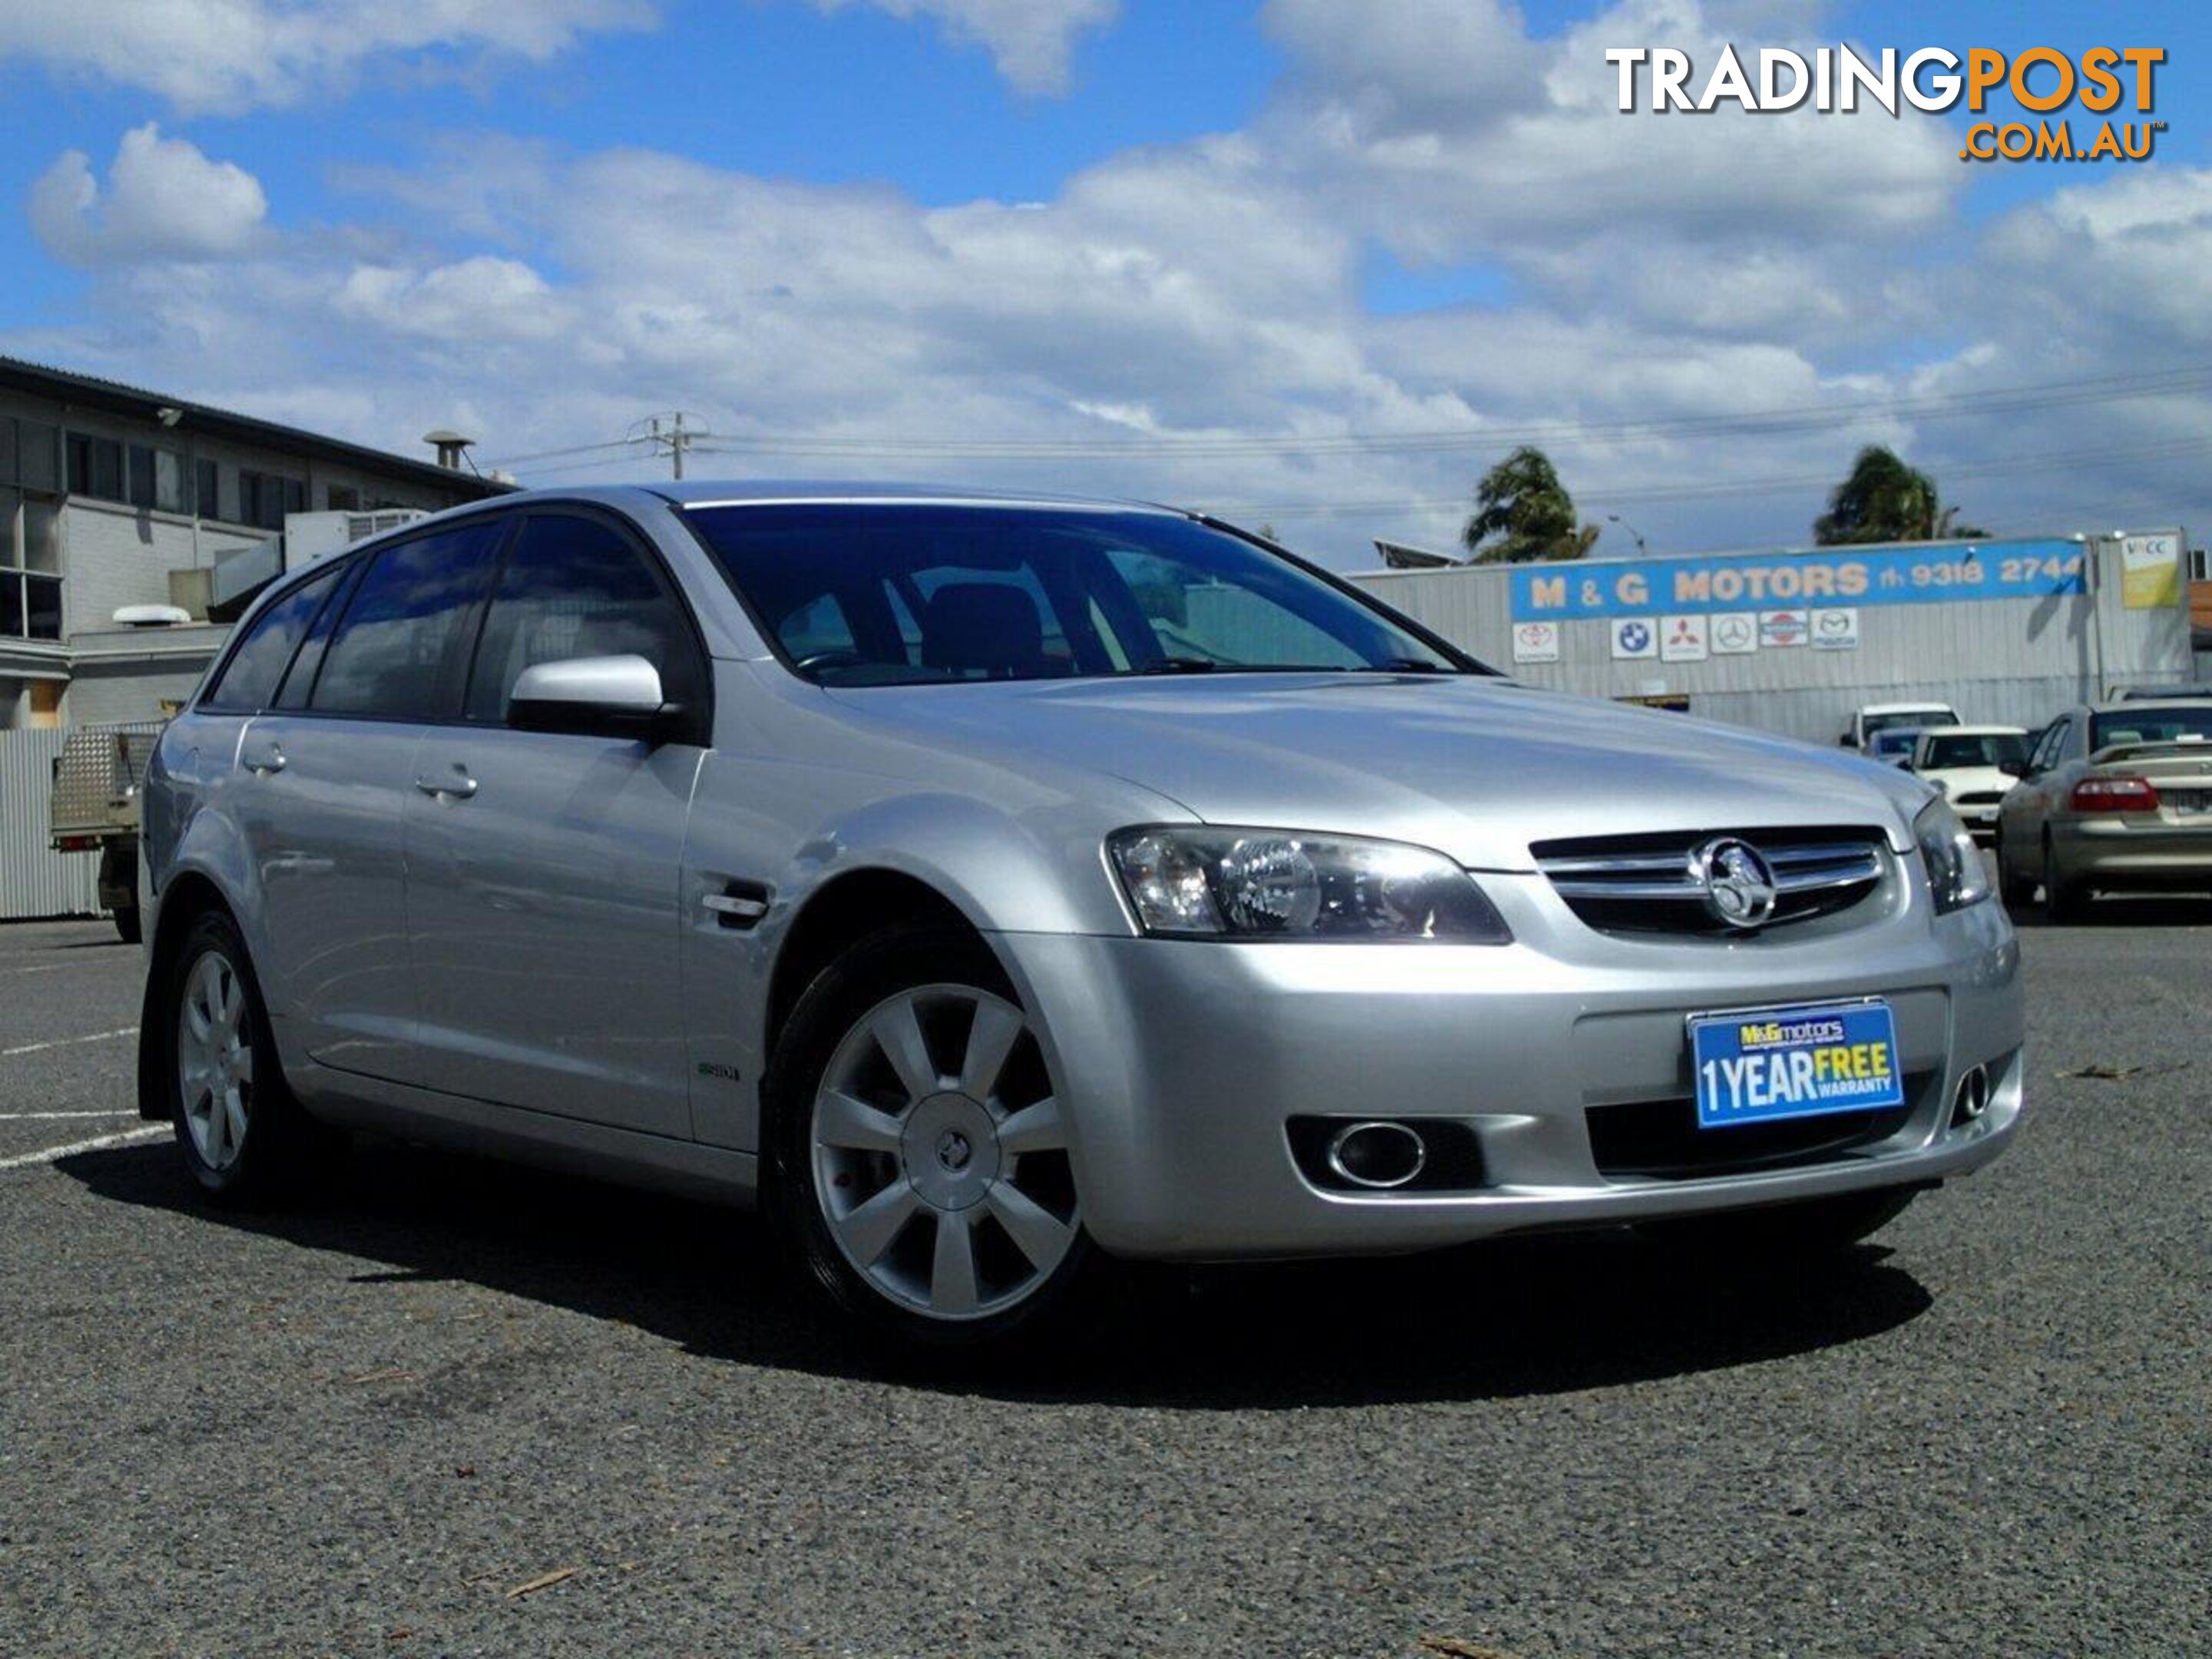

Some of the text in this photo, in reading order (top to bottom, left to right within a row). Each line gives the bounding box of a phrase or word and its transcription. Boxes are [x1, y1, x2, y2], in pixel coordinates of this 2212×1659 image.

[2127, 540, 2167, 554] VCC
[1532, 576, 1566, 608] M
[1581, 581, 1602, 606] &
[1615, 573, 1649, 605] G
[1675, 561, 1868, 602] MOTORS
[1912, 561, 1984, 587] 9318
[2002, 555, 2081, 582] 2744
[1702, 1051, 1819, 1111] 1 YEAR
[1813, 1042, 1891, 1081] FREE
[1818, 1076, 1891, 1098] WARRANTY
